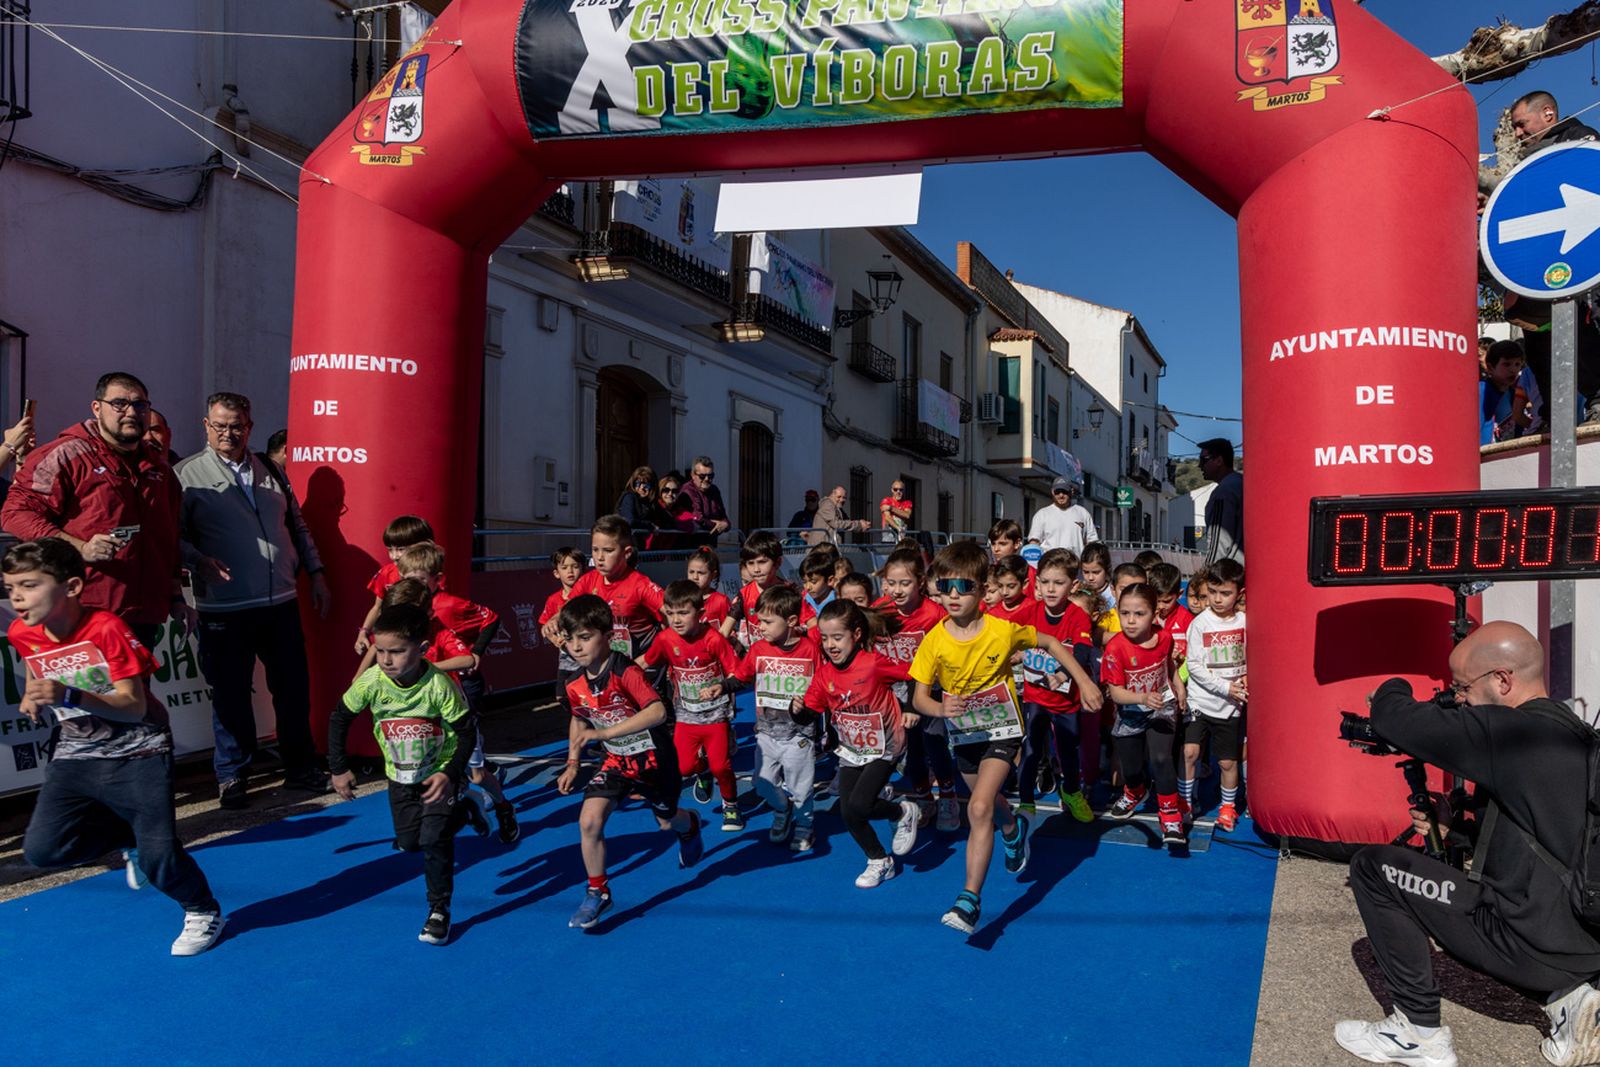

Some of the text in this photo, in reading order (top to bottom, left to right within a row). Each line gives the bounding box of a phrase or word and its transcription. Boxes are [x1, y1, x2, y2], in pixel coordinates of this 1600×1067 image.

[628, 0, 787, 42] CROSS
[557, 0, 661, 134] X
[633, 31, 1056, 118] DEL VÍBORAS
[1266, 91, 1311, 107] MARTOS
[369, 155, 401, 164] MARTOS
[1269, 326, 1468, 362] AYUNTAMIENTO
[1356, 385, 1395, 405] DE
[313, 400, 339, 416] DE
[292, 446, 368, 464] MARTOS
[1315, 444, 1433, 467] MARTOS
[36, 651, 89, 674] X CROSS
[764, 674, 808, 694] 1162
[387, 722, 434, 735] X CROSS
[1381, 863, 1456, 905] Joma
